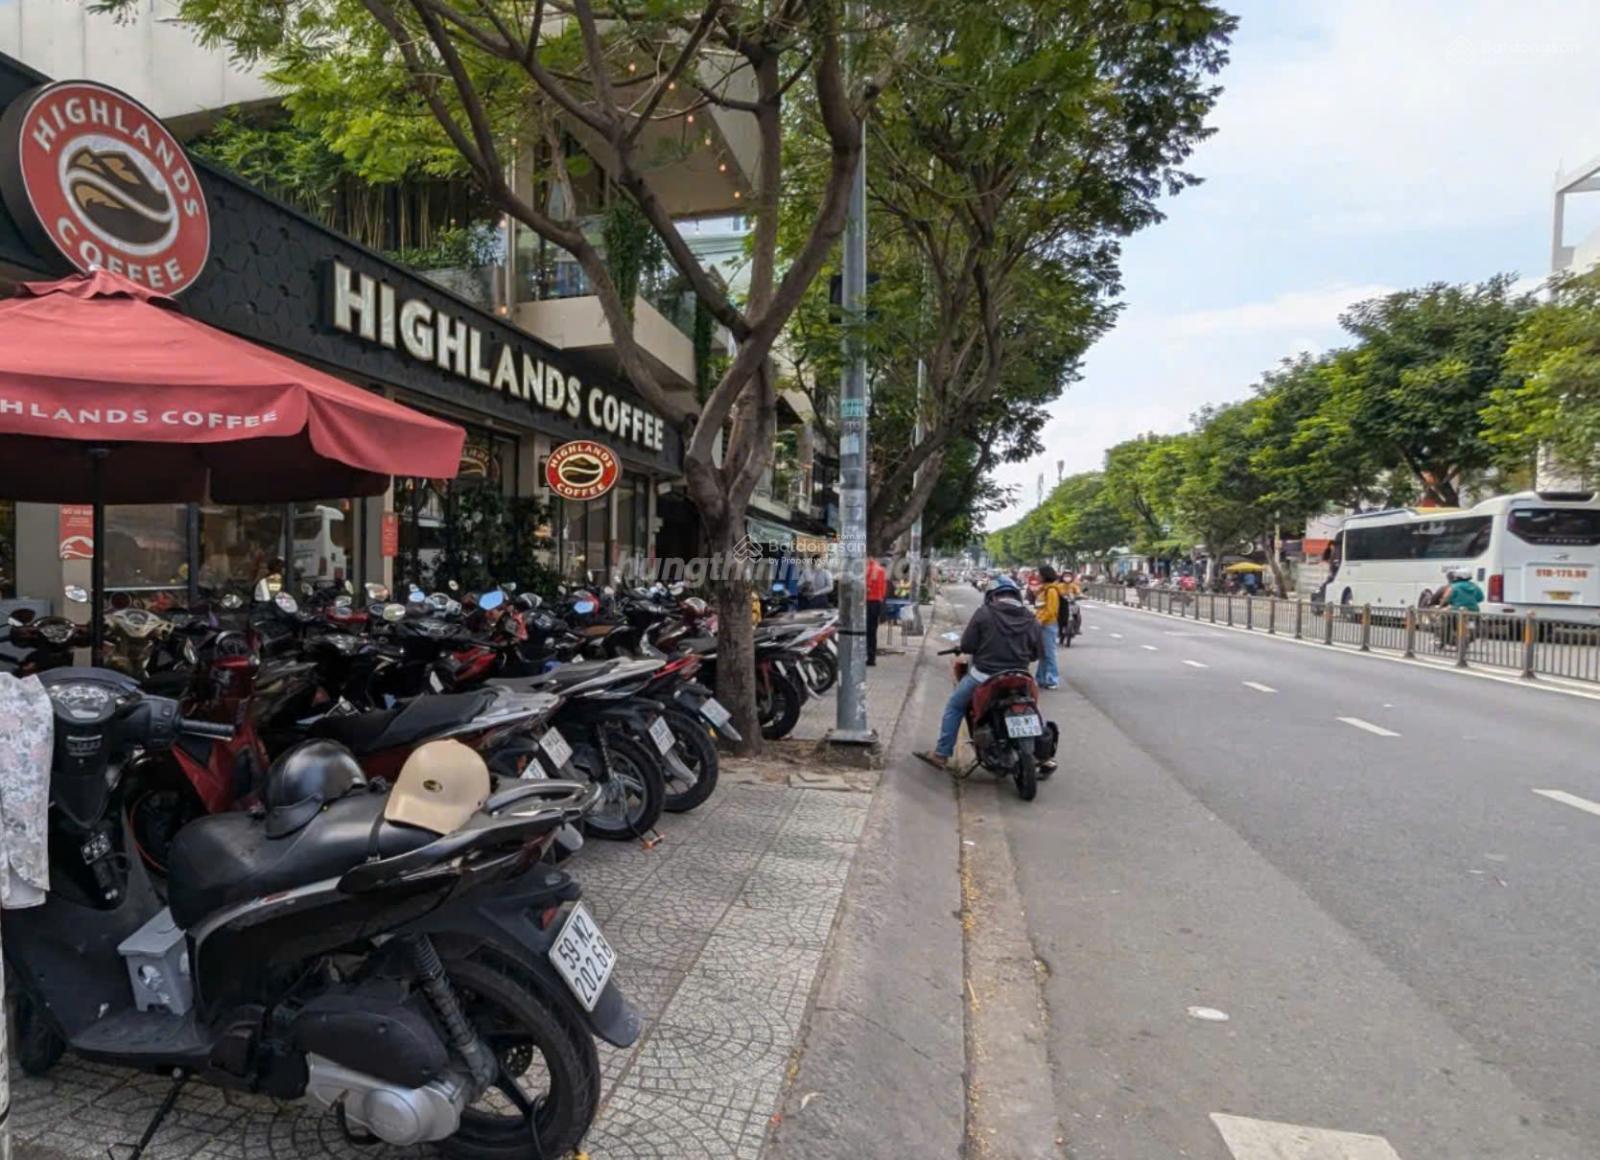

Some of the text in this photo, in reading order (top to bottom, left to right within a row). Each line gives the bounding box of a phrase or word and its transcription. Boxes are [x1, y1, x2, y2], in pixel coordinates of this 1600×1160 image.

[32, 97, 200, 218] HIGHLANDS
[56, 217, 184, 288] COFFEE
[333, 261, 664, 451] HIGHLANDS COFFEE
[161, 408, 279, 429] COFFEE
[549, 444, 614, 468] HIGHLANDS
[556, 483, 606, 497] COFFEE
